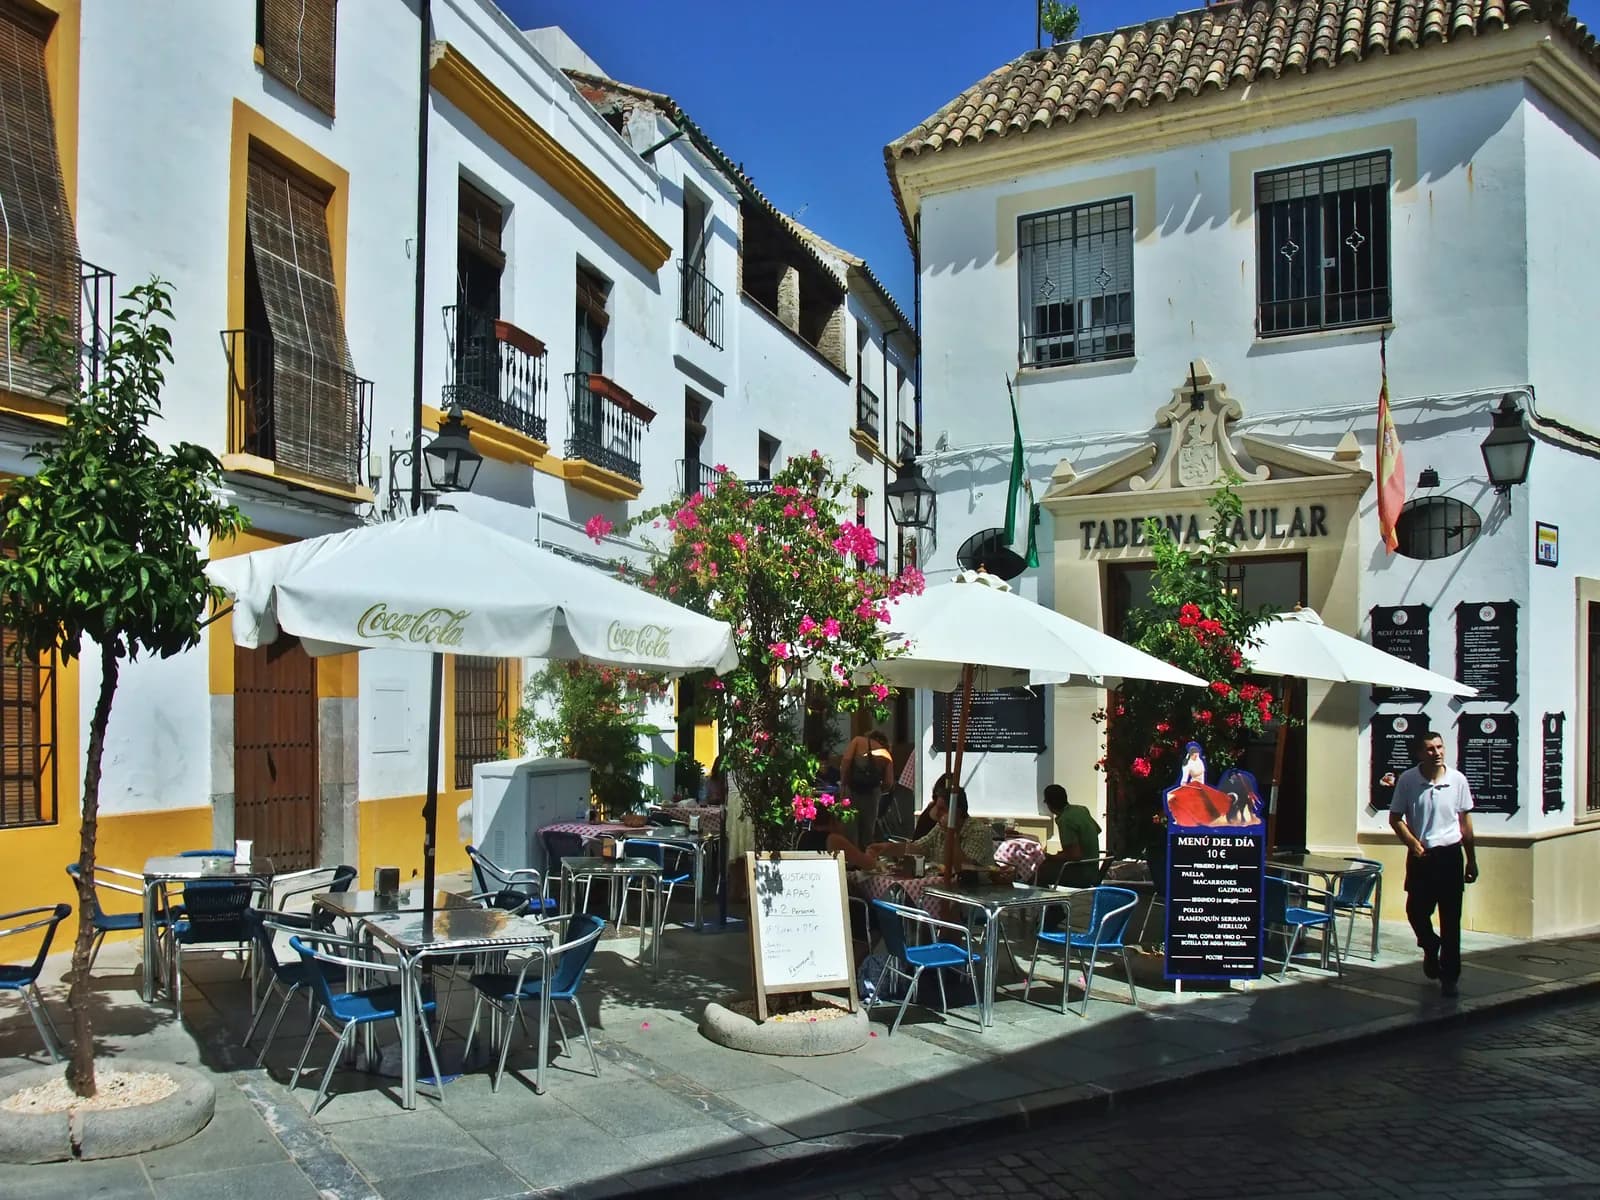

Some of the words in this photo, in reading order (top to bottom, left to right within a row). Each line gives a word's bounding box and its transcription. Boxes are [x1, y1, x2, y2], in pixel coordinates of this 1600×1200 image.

[1079, 514, 1200, 550] TABERNA
[1211, 505, 1328, 545] AULAR
[357, 602, 472, 646] Coca-Cola
[606, 619, 673, 659] Coca-Cola
[1178, 835, 1210, 846] MENÚ
[1212, 838, 1232, 847] DEL
[1235, 836, 1255, 848] DÍA
[1207, 849, 1218, 859] 10
[1219, 849, 1227, 859] €
[780, 903, 787, 914] 2
